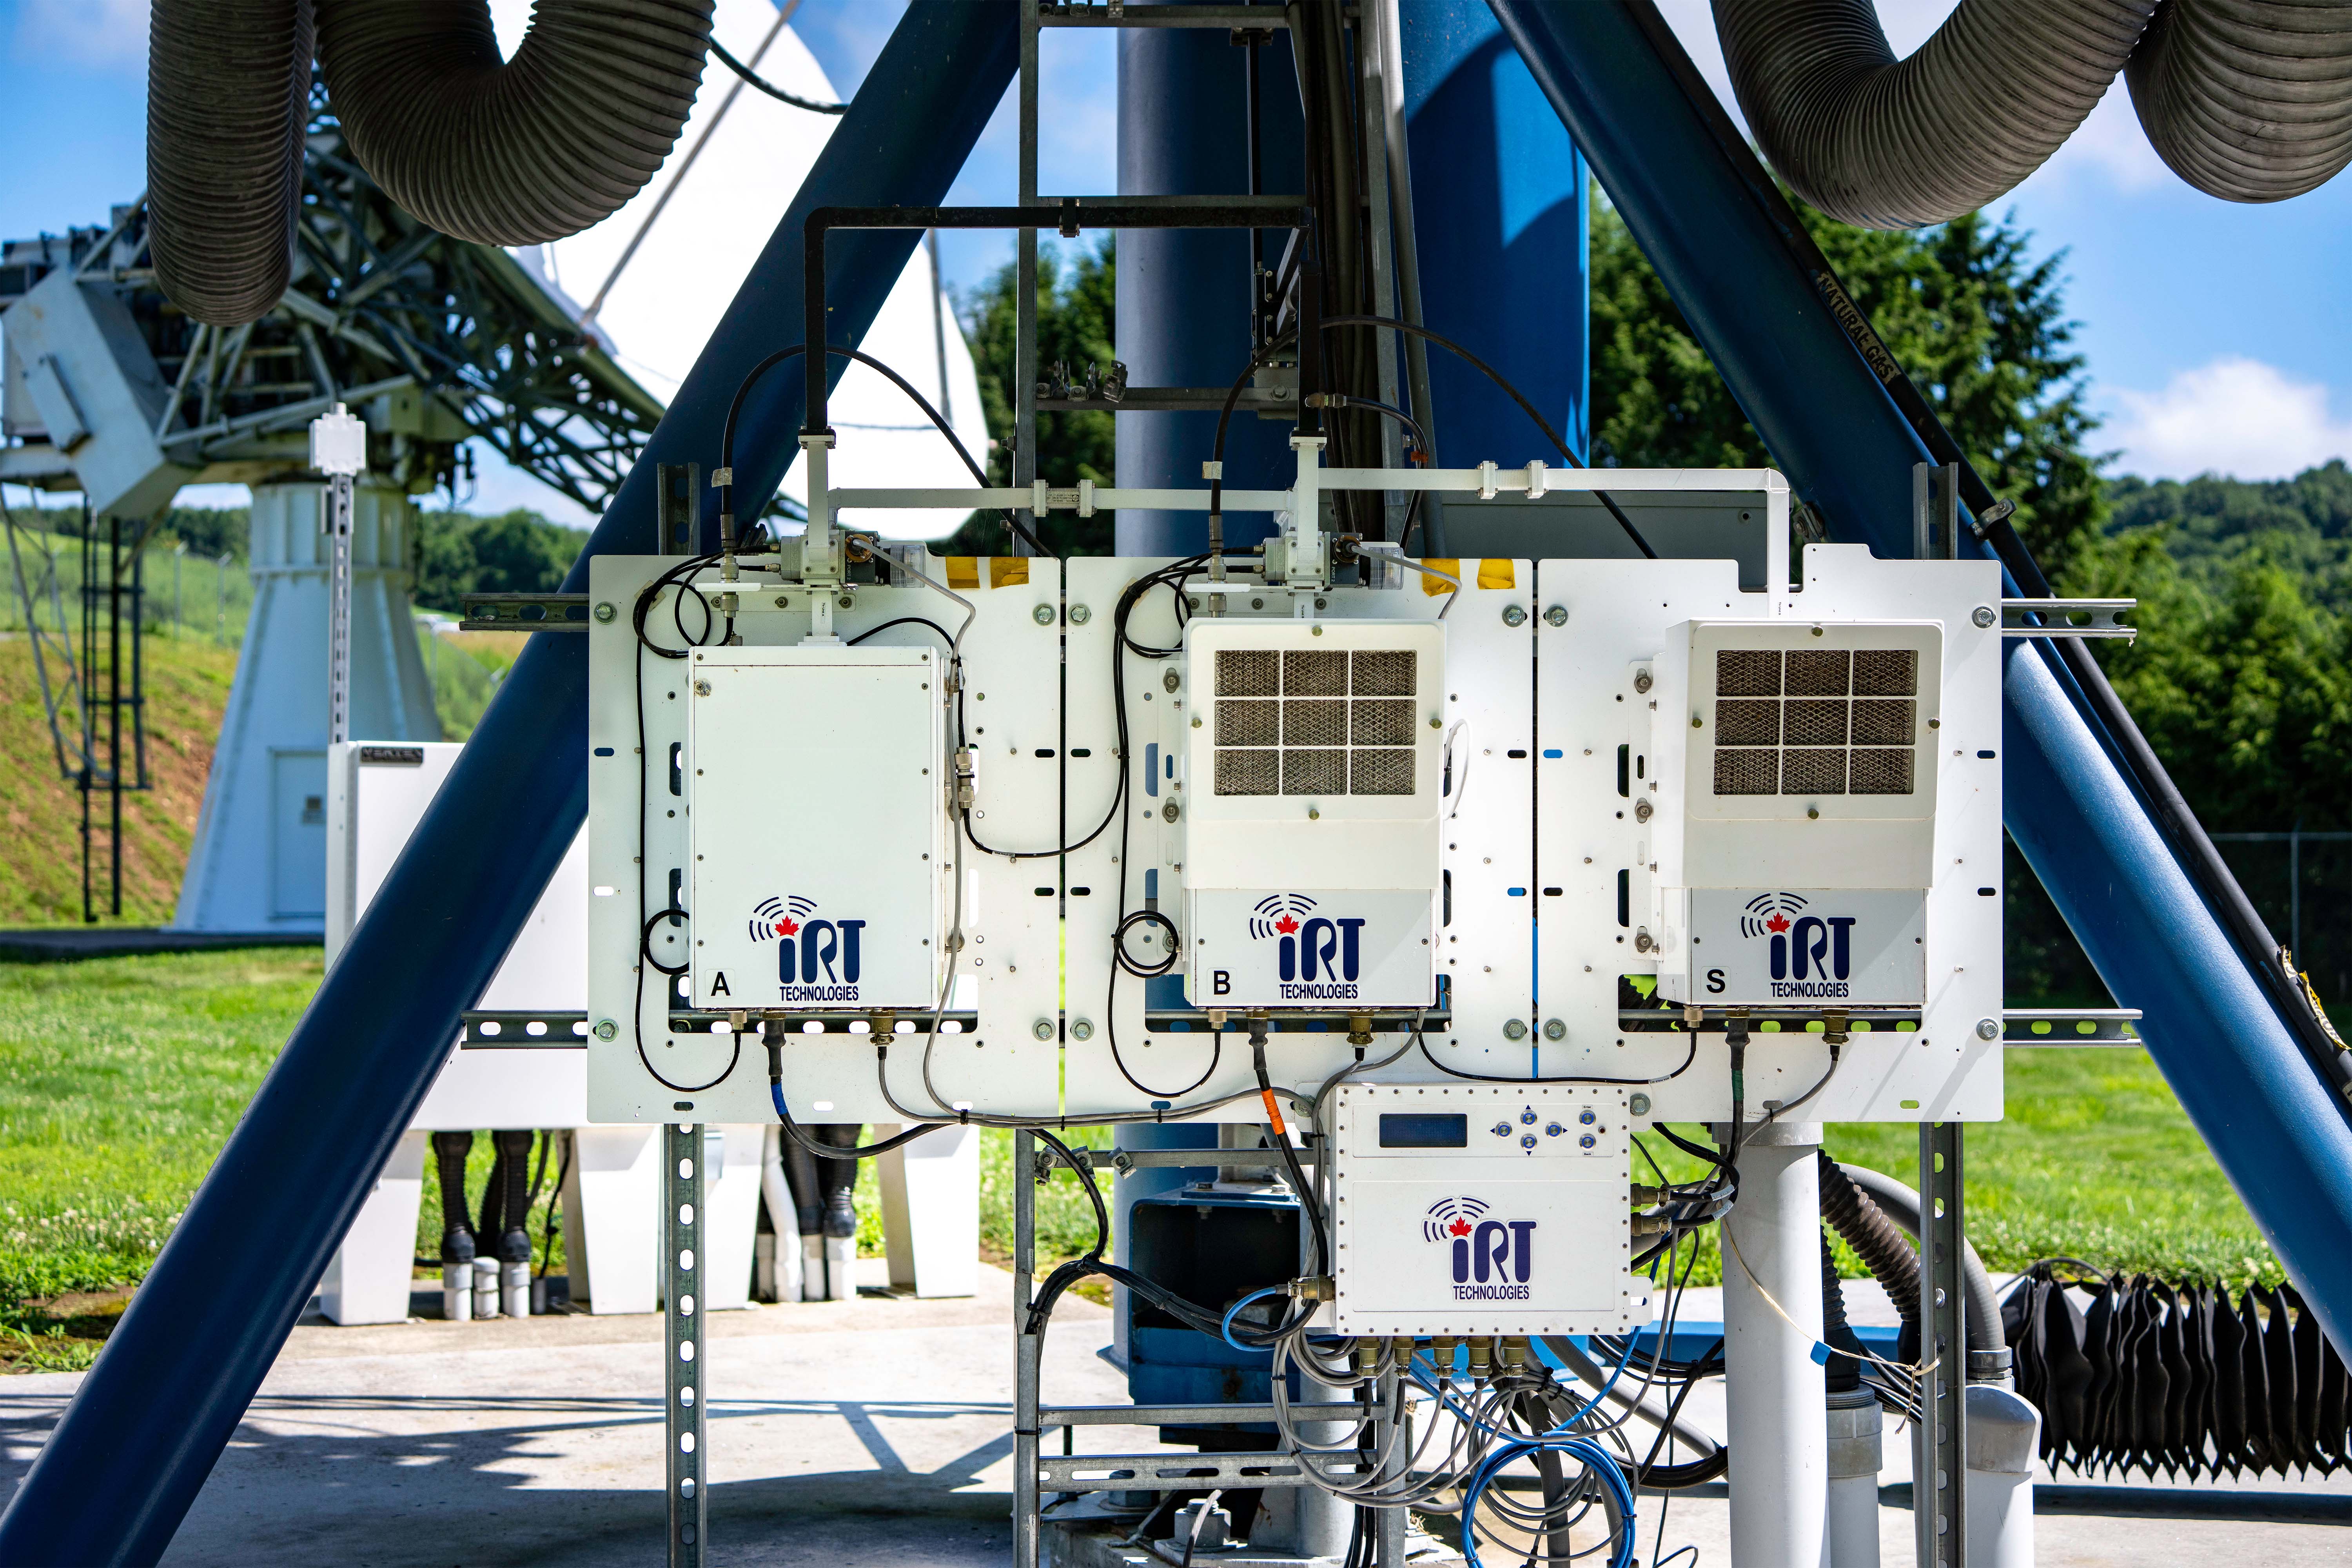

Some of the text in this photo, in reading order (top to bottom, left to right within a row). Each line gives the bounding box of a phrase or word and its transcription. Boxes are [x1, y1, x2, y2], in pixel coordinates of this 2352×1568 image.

[1818, 277, 1894, 379] NATURAL GAS
[775, 915, 866, 984] iRT
[1275, 913, 1365, 982] iRT
[1766, 911, 1856, 980] iRT
[711, 971, 731, 996] A
[779, 985, 859, 1001] TECHNOLOGIES
[1214, 970, 1230, 995] B
[1279, 984, 1358, 999] TECHNOLOGIES
[1706, 969, 1726, 993] S
[1770, 982, 1849, 998] TECHNOLOGIES
[1448, 1215, 1537, 1283] iRT
[1453, 1285, 1529, 1300] TECHNOLOGIES
